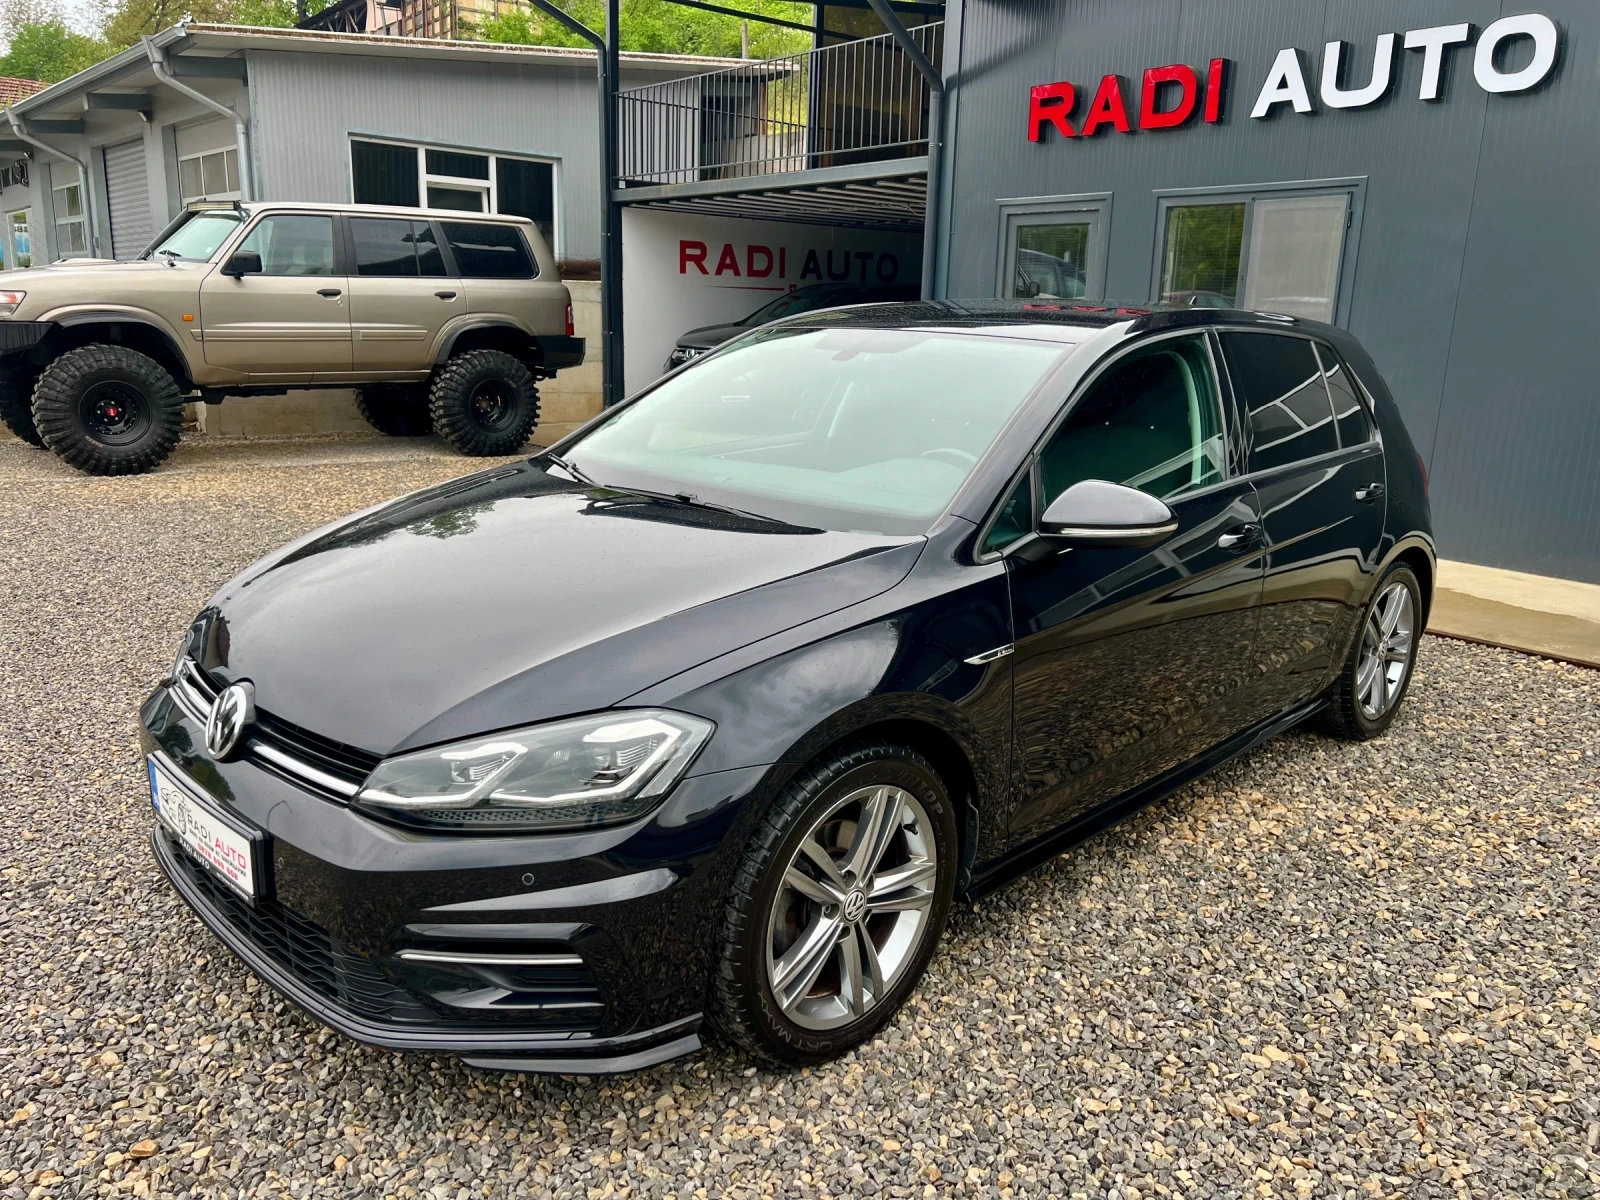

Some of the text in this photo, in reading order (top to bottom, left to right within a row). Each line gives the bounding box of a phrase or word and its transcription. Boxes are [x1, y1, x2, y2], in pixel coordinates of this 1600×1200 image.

[1028, 12, 1560, 142] RADI AUTO
[679, 239, 899, 282] RADI AUTO
[179, 836, 193, 854] RADI
[193, 851, 210, 869] AUTO
[187, 813, 212, 843] RADI
[215, 837, 247, 870] AUTO
